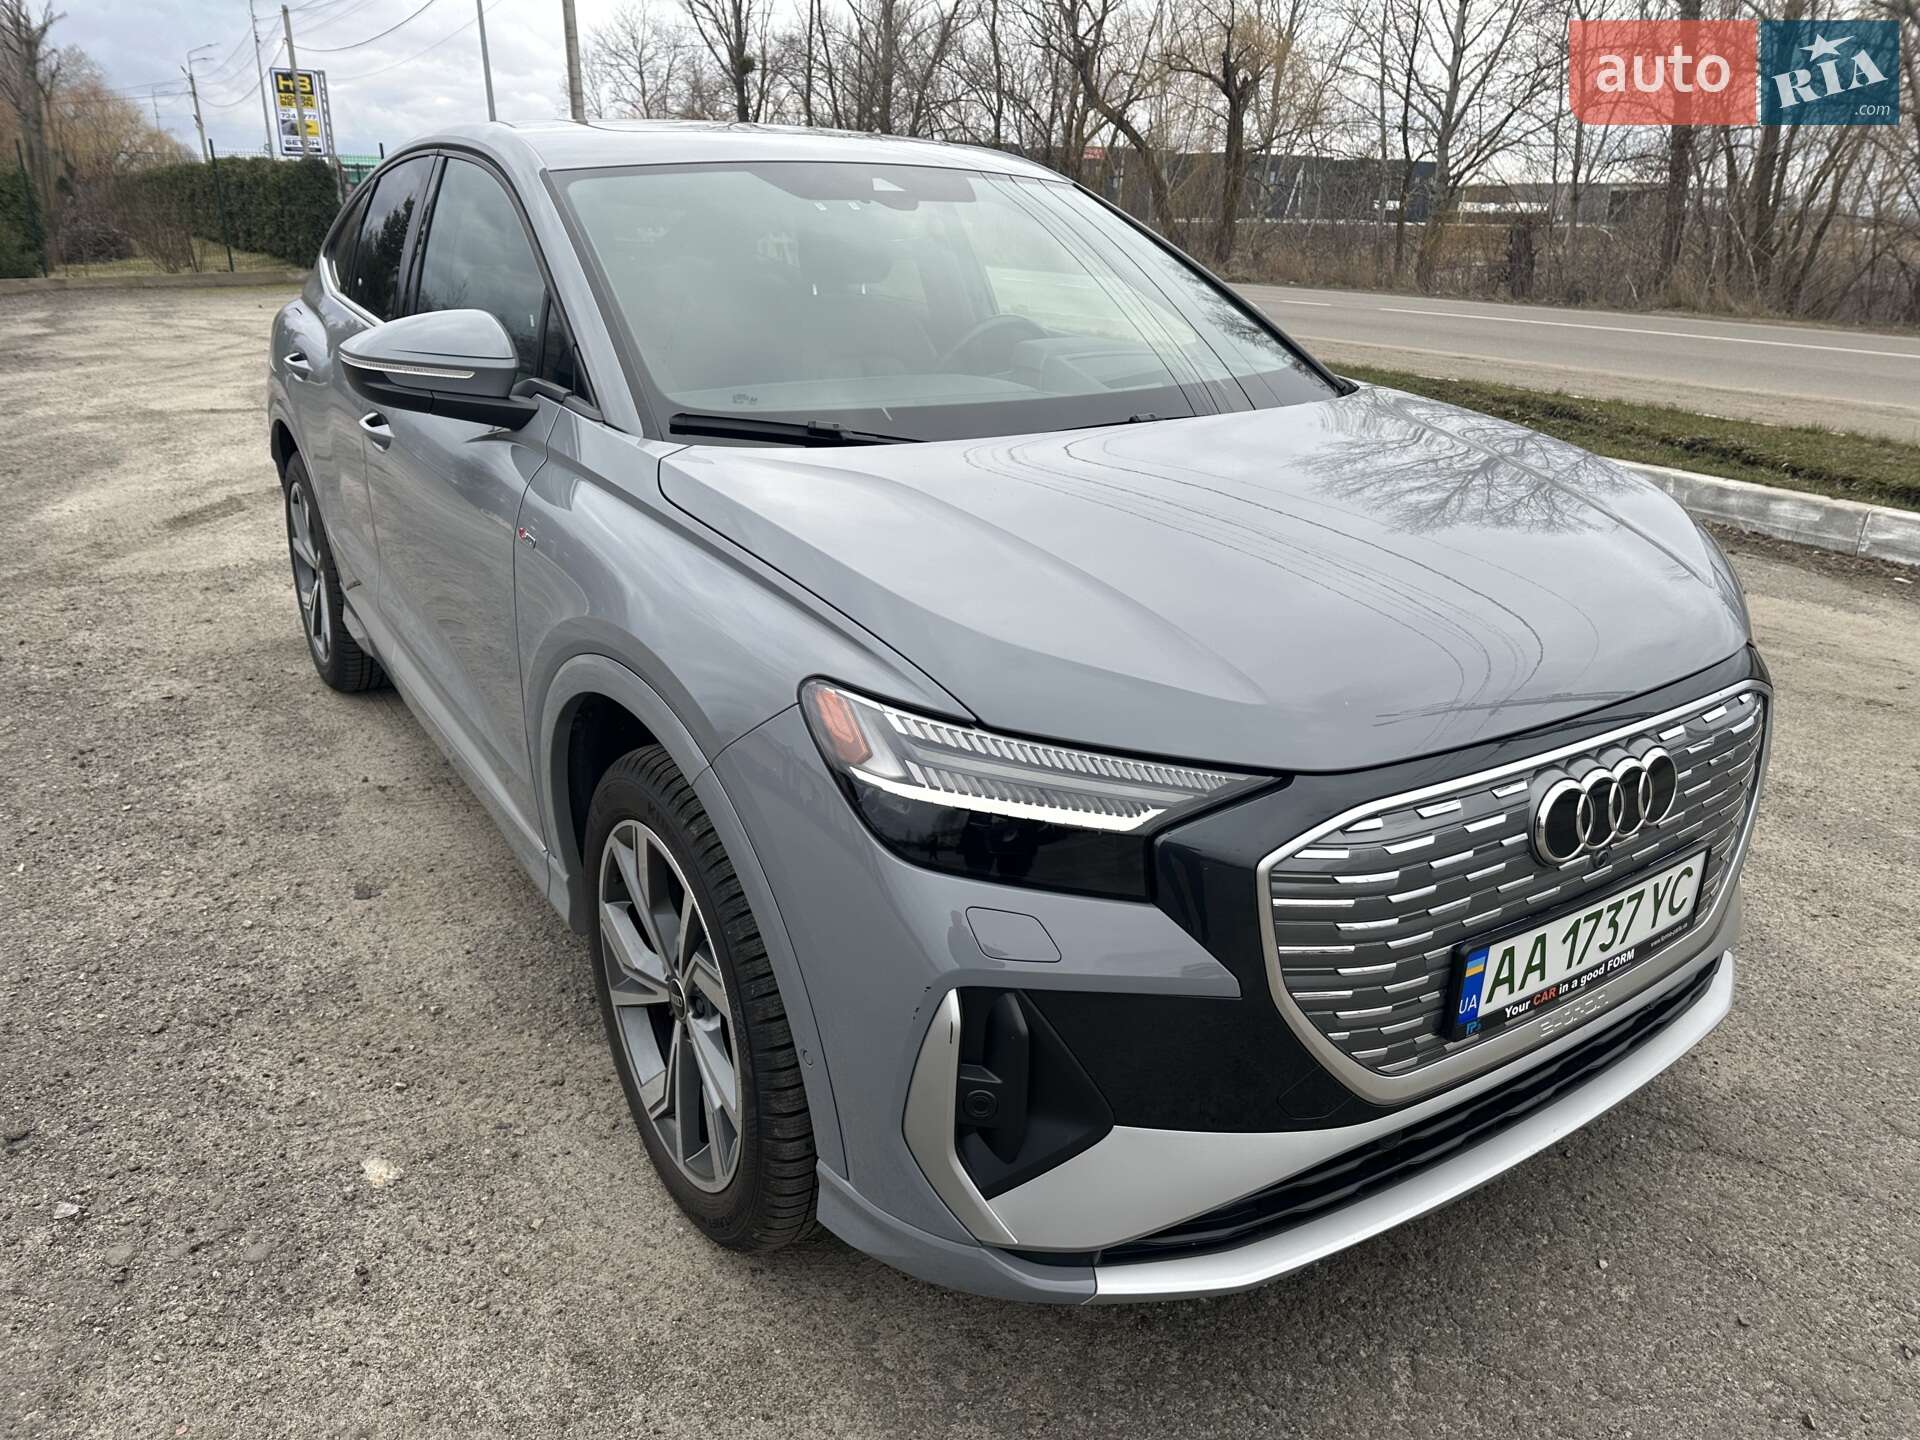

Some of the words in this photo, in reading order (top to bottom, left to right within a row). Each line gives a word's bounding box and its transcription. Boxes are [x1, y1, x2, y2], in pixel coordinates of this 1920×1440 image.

[1485, 933, 1547, 1004] AA
[1561, 889, 1646, 970] 1737
[1650, 866, 1694, 929] YC
[1459, 994, 1478, 1014] UA
[1505, 1000, 1531, 1018] Your
[1533, 986, 1558, 1006] CAR
[1559, 983, 1569, 995] in
[1571, 979, 1578, 989] a
[1580, 963, 1605, 986] good
[1607, 948, 1635, 971] FORM
